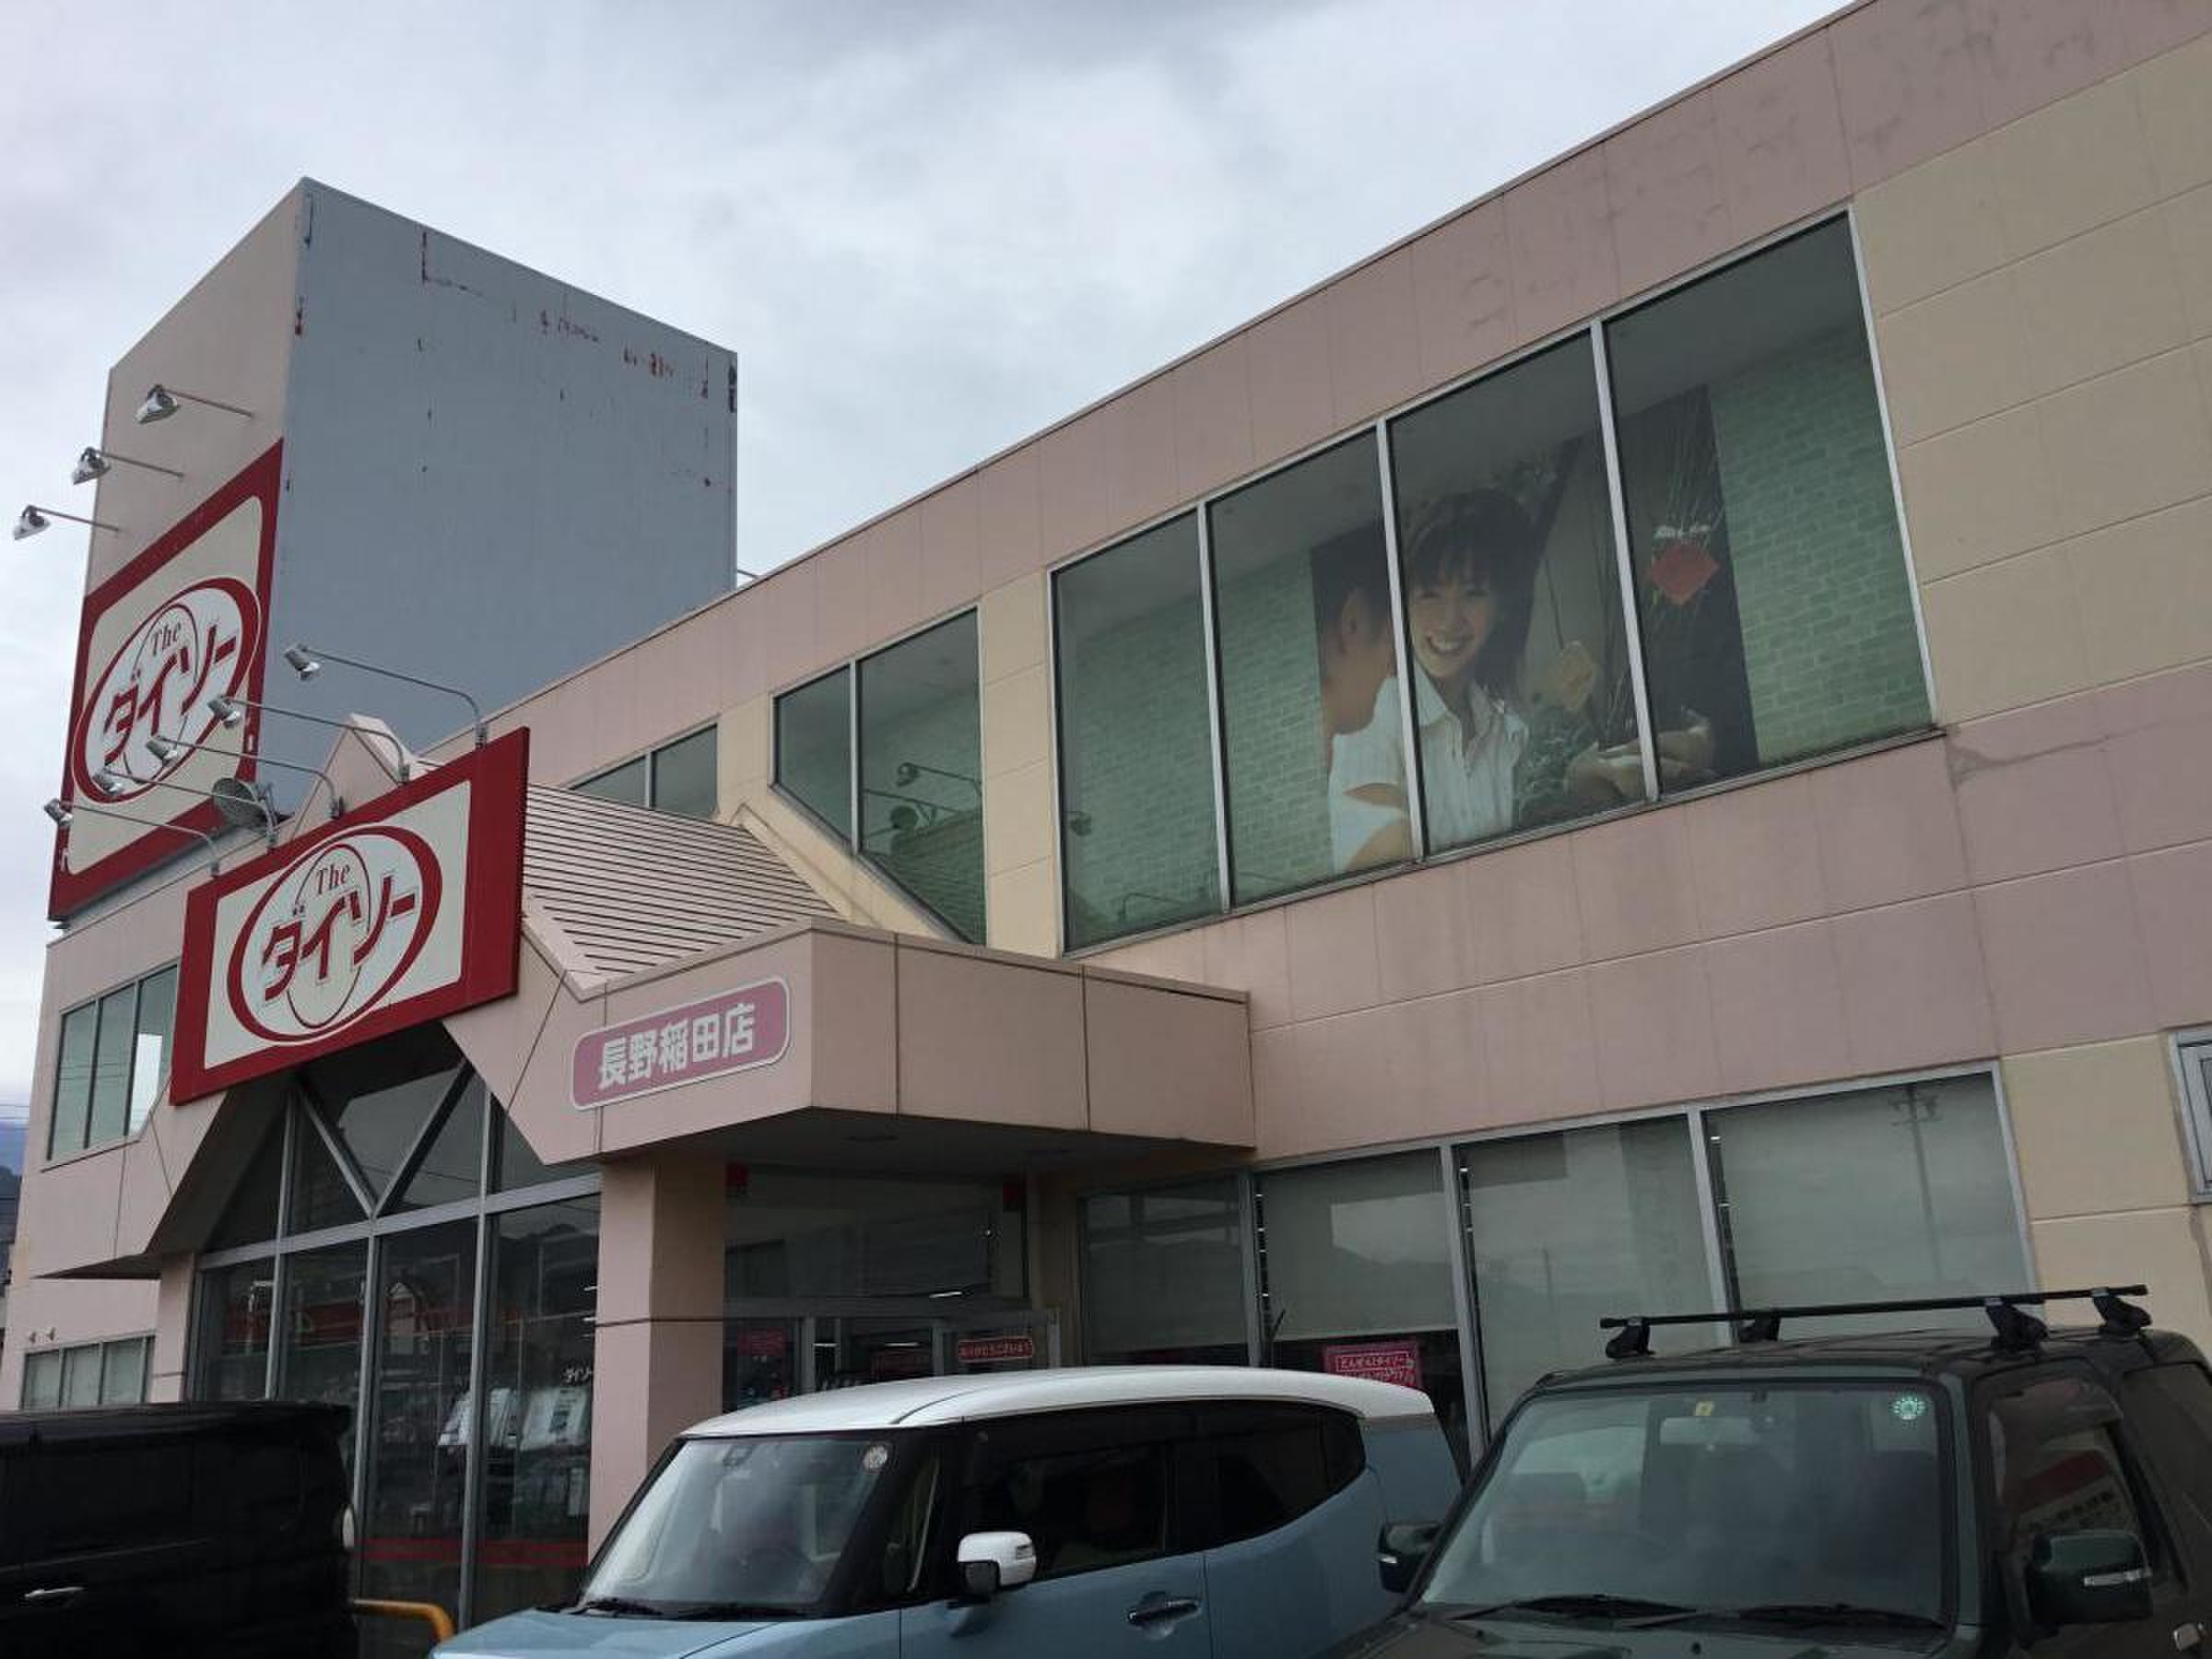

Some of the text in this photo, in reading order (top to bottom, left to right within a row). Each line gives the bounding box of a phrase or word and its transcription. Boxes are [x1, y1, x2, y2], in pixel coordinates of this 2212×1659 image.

[151, 621, 182, 657] The
[103, 624, 237, 766] ダイソー
[316, 864, 350, 895] The
[262, 875, 415, 1002] ダイソー
[599, 1002, 756, 1090] 長野稲田店
